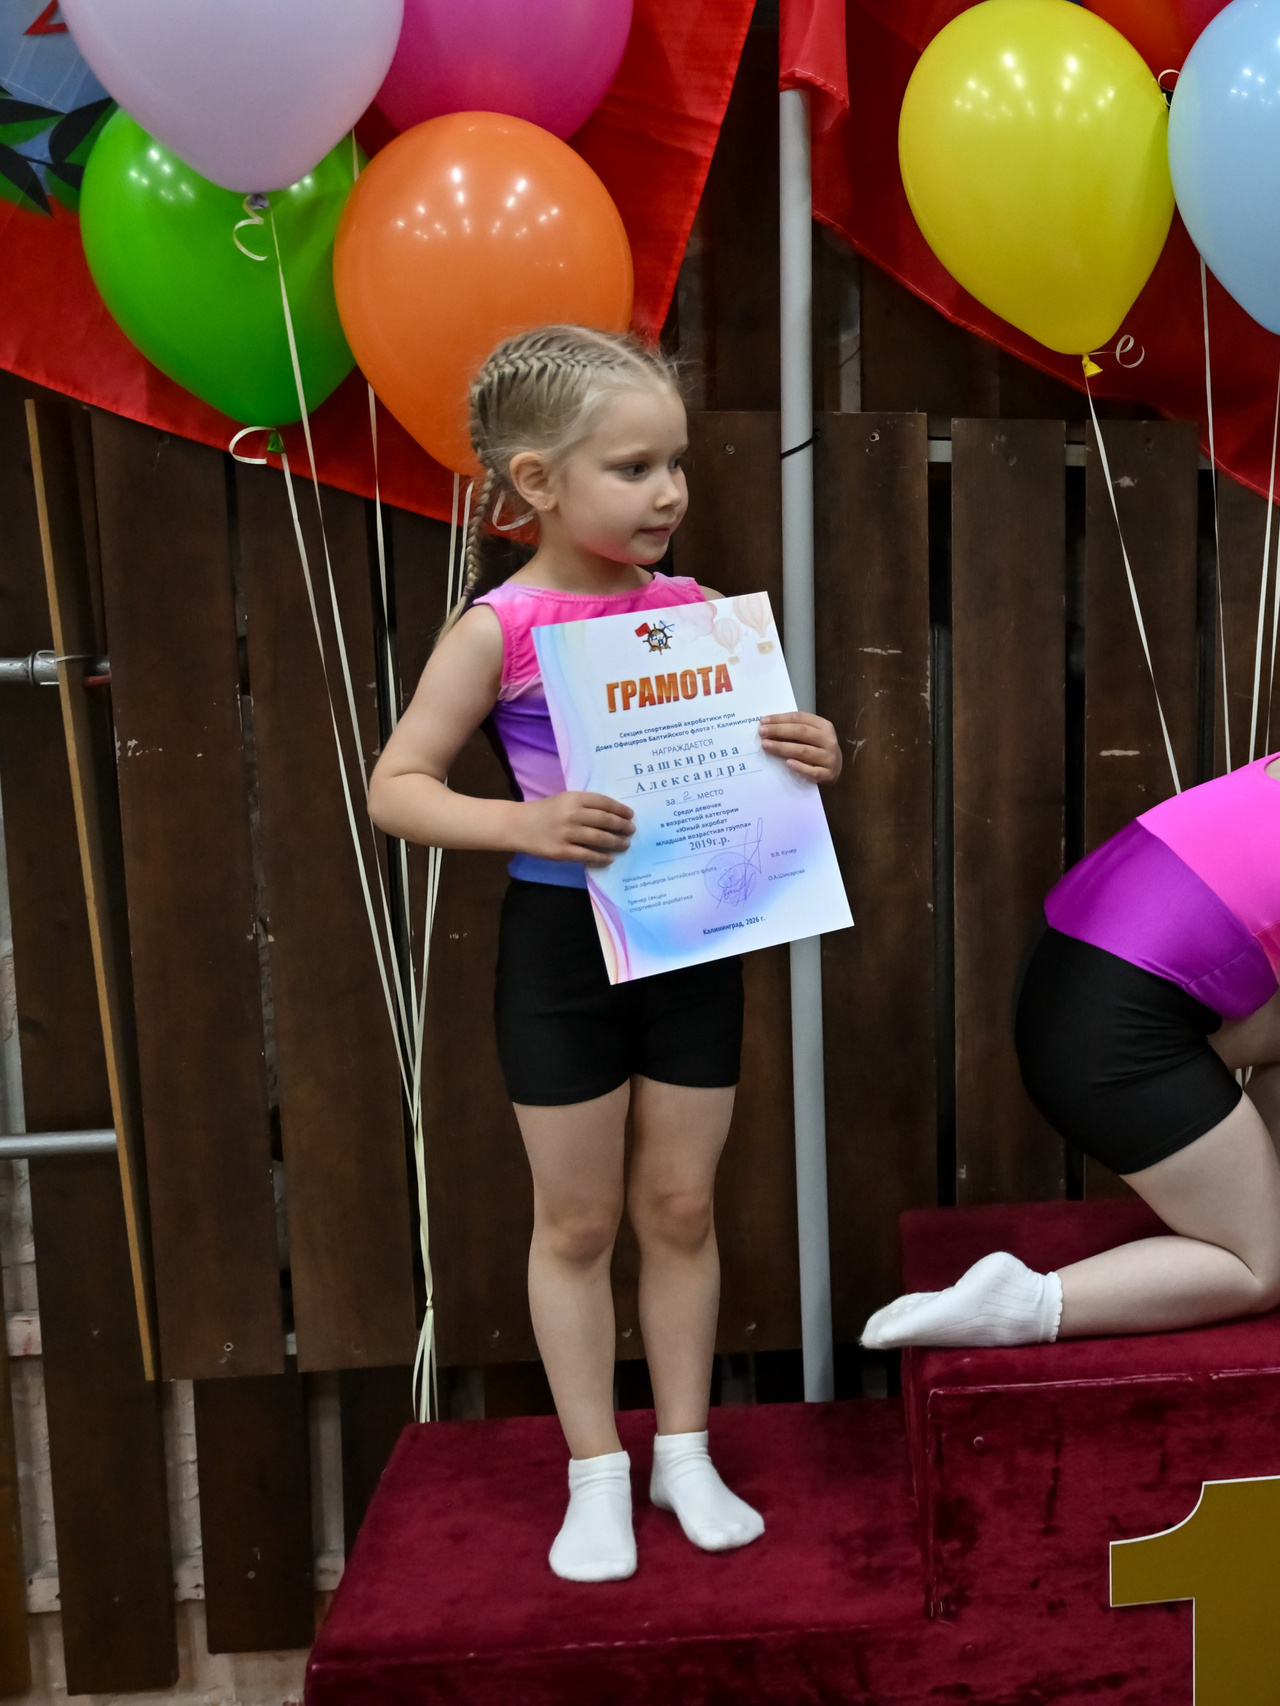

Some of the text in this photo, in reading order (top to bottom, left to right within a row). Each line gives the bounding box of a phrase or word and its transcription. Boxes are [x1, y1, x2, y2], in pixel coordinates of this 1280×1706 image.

[606, 663, 734, 713] ГРАМОТА
[619, 712, 735, 738] Секция спортивной акробатики при
[595, 744, 613, 752] Доме
[614, 738, 647, 748] Офицеров
[648, 730, 689, 742] Балтийского
[690, 726, 710, 735] флота
[652, 738, 714, 757] НАГРАЖДАЕТСЯ
[633, 746, 739, 775] Башкирова
[635, 762, 747, 793] Александра
[666, 799, 676, 807] за
[697, 788, 724, 800] место
[673, 802, 722, 817] Среди девочек
[666, 814, 703, 827] возрастной
[705, 807, 739, 819] категории
[675, 818, 728, 833] «Юный акробат
[656, 822, 752, 847] младшая возрастная группа»
